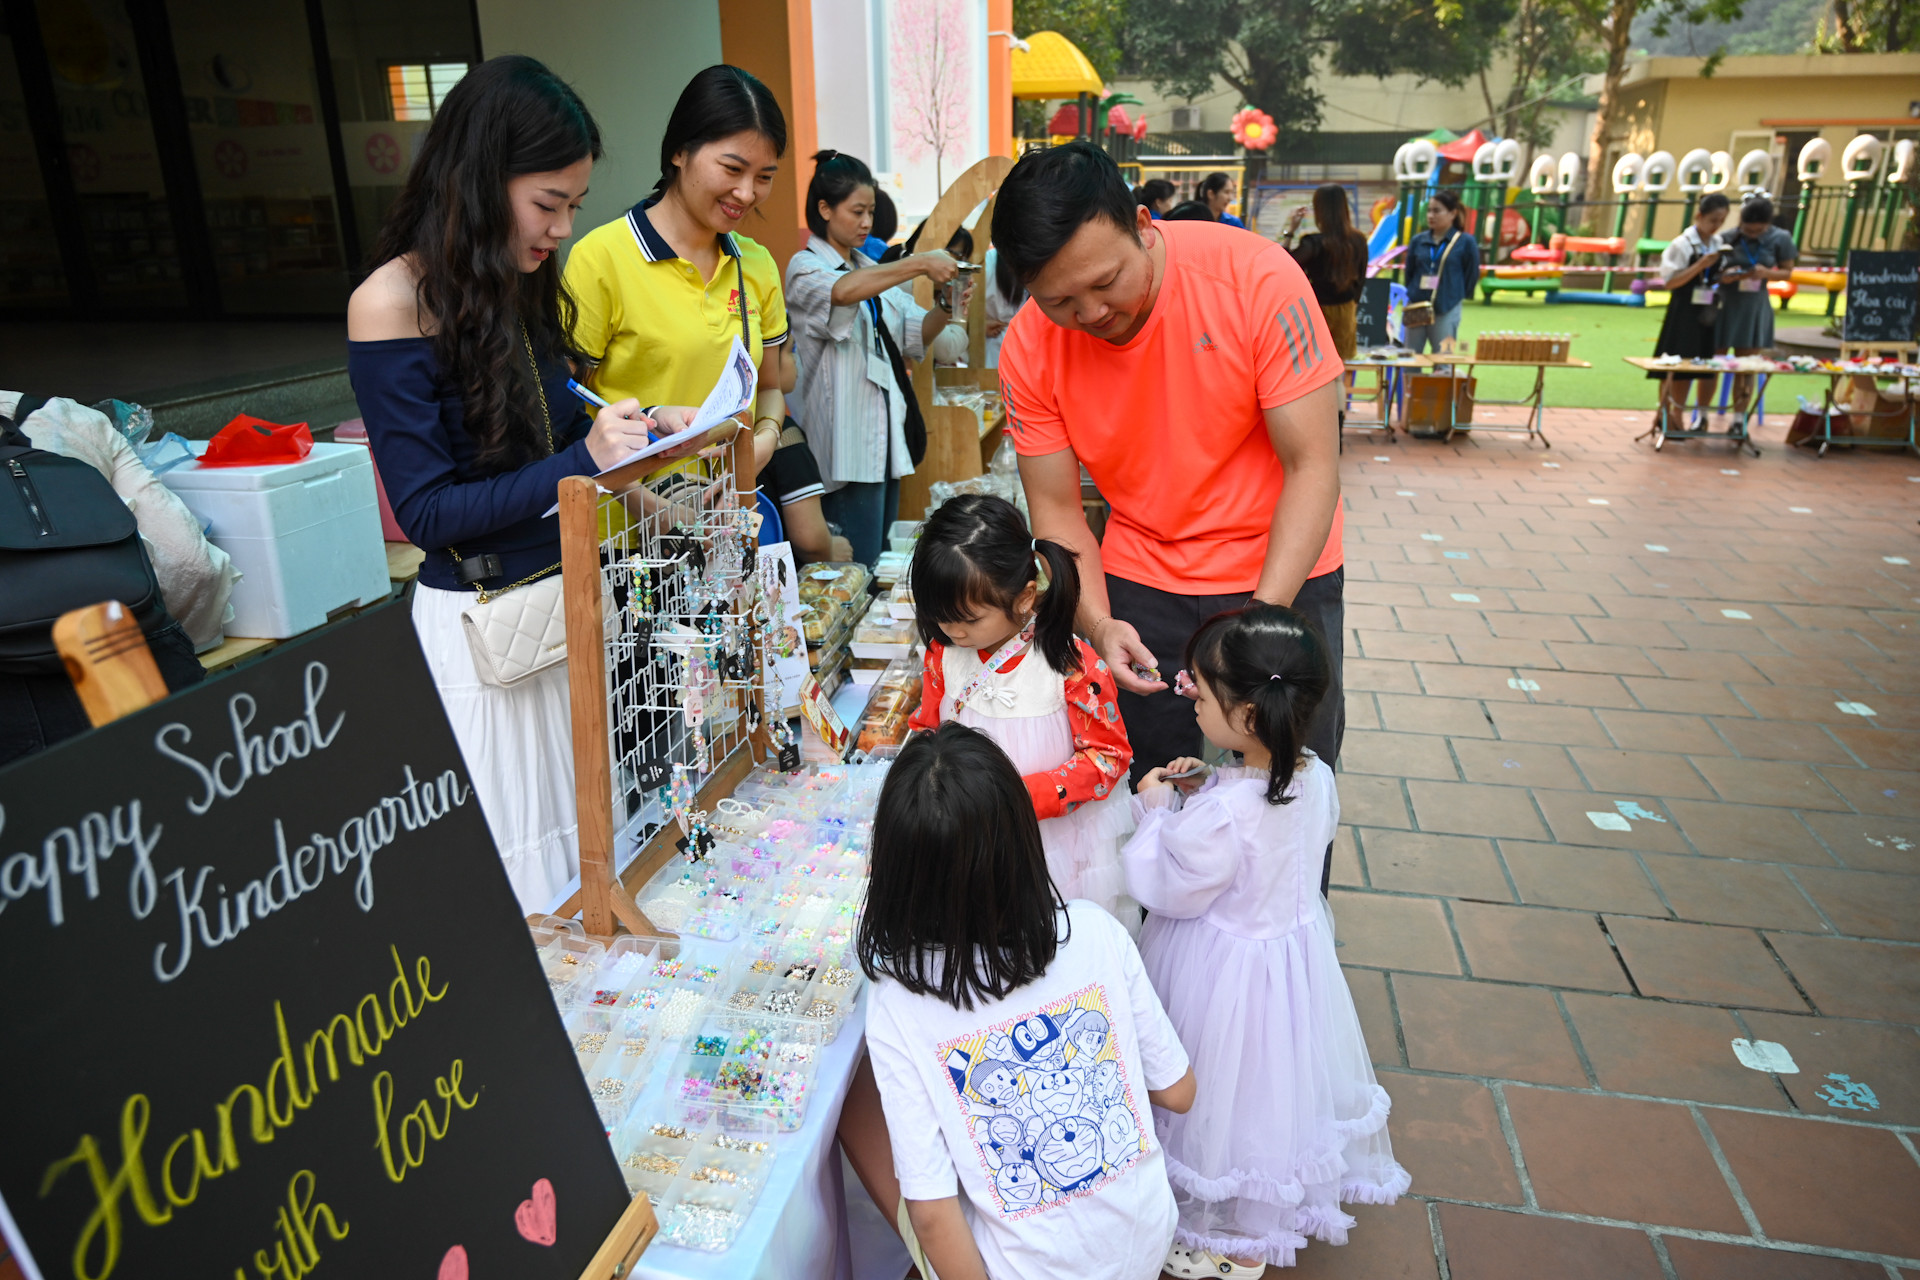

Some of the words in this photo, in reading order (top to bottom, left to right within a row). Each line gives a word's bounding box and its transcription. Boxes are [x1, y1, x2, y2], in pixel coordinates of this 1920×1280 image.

[0, 800, 163, 928] appy
[155, 660, 346, 815] School
[153, 765, 471, 982] Kindergarten
[38, 945, 449, 1280] Handmade
[374, 1058, 478, 1182] love
